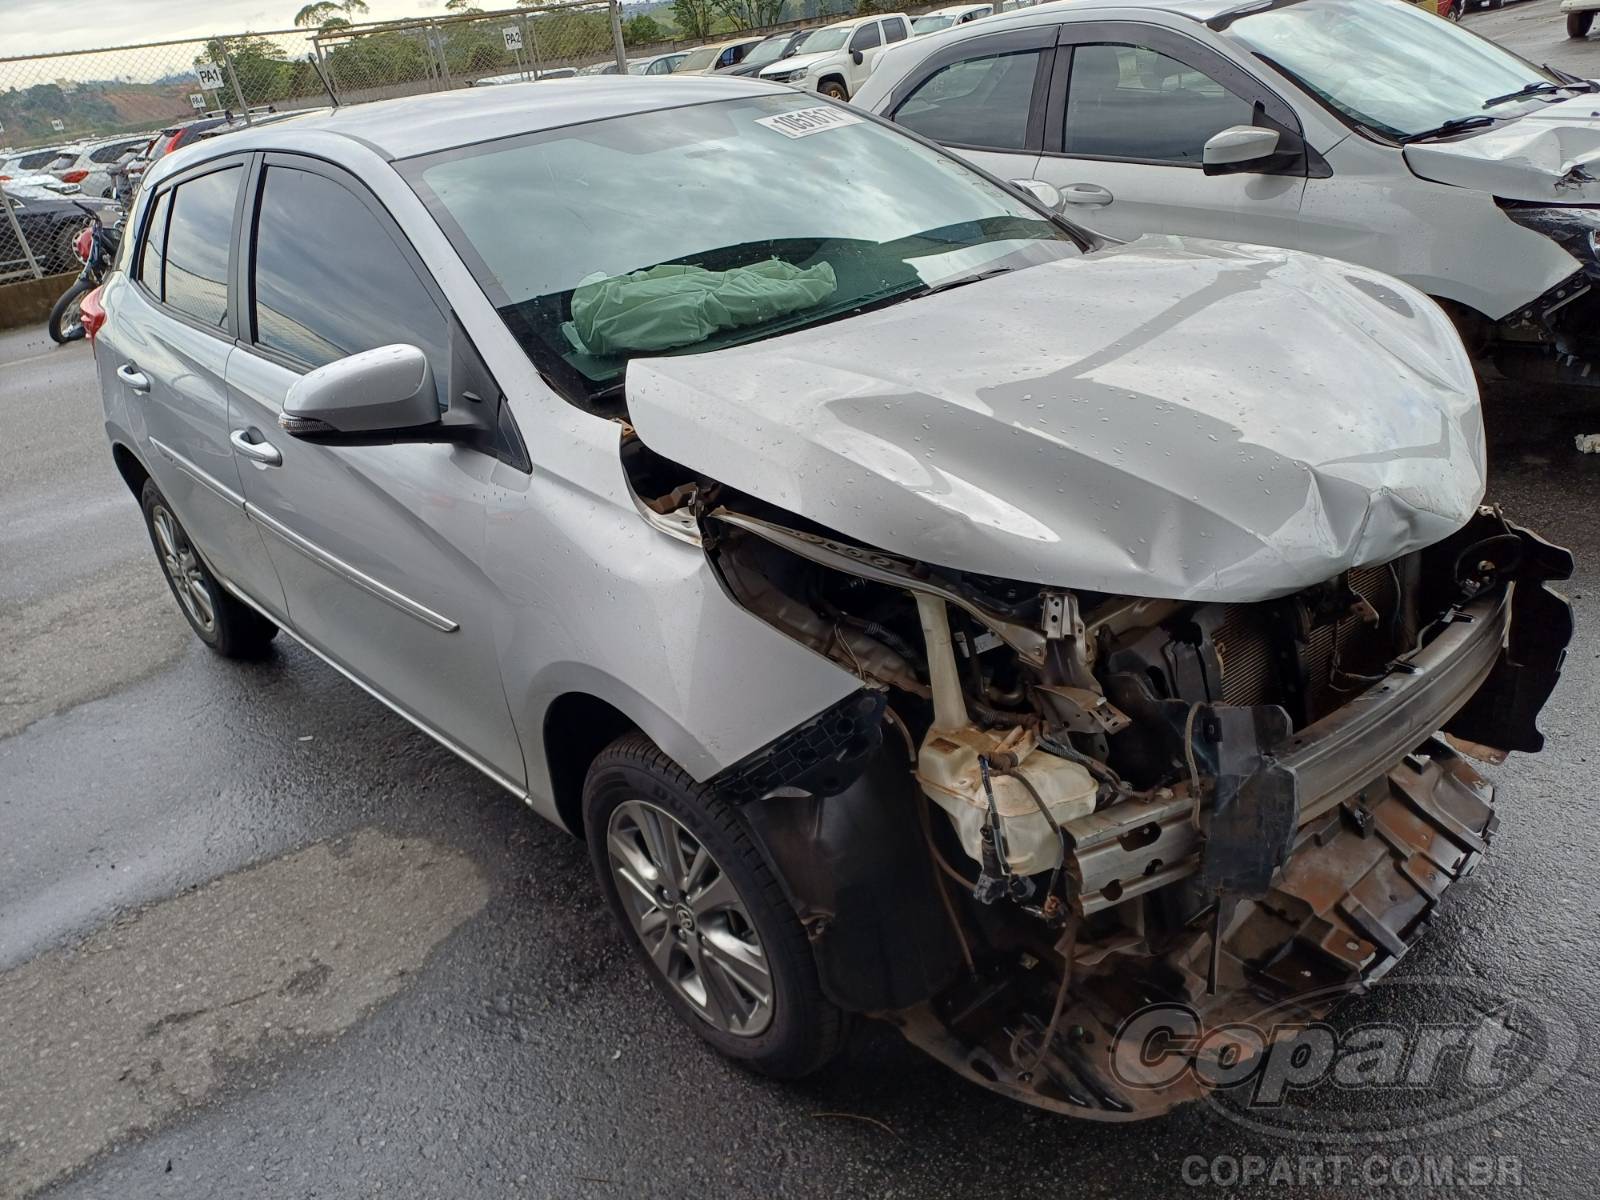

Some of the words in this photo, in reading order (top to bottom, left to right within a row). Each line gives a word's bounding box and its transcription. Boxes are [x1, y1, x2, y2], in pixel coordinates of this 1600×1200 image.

[505, 32, 521, 45] PA2
[199, 69, 220, 83] PA1
[772, 108, 844, 131] 1051617
